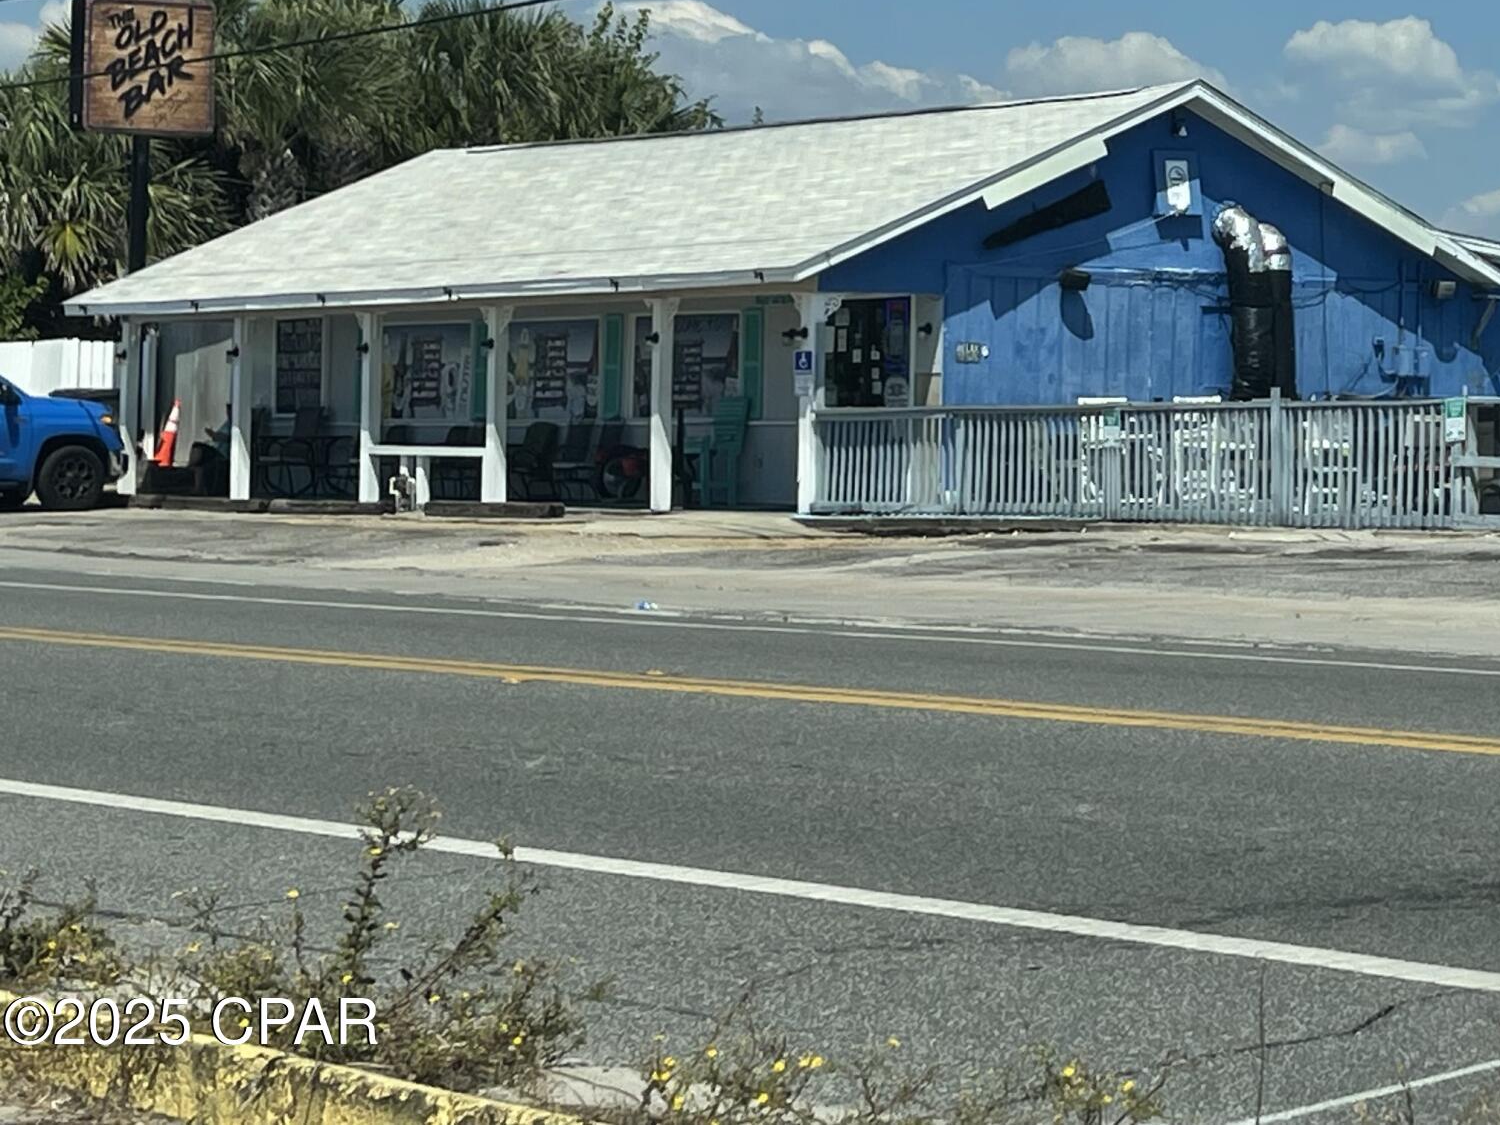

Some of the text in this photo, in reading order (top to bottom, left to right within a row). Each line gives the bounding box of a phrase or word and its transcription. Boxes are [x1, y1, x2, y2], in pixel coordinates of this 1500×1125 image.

[105, 6, 194, 91] BEACH
[115, 11, 168, 50] OLD
[118, 56, 194, 120] BAR
